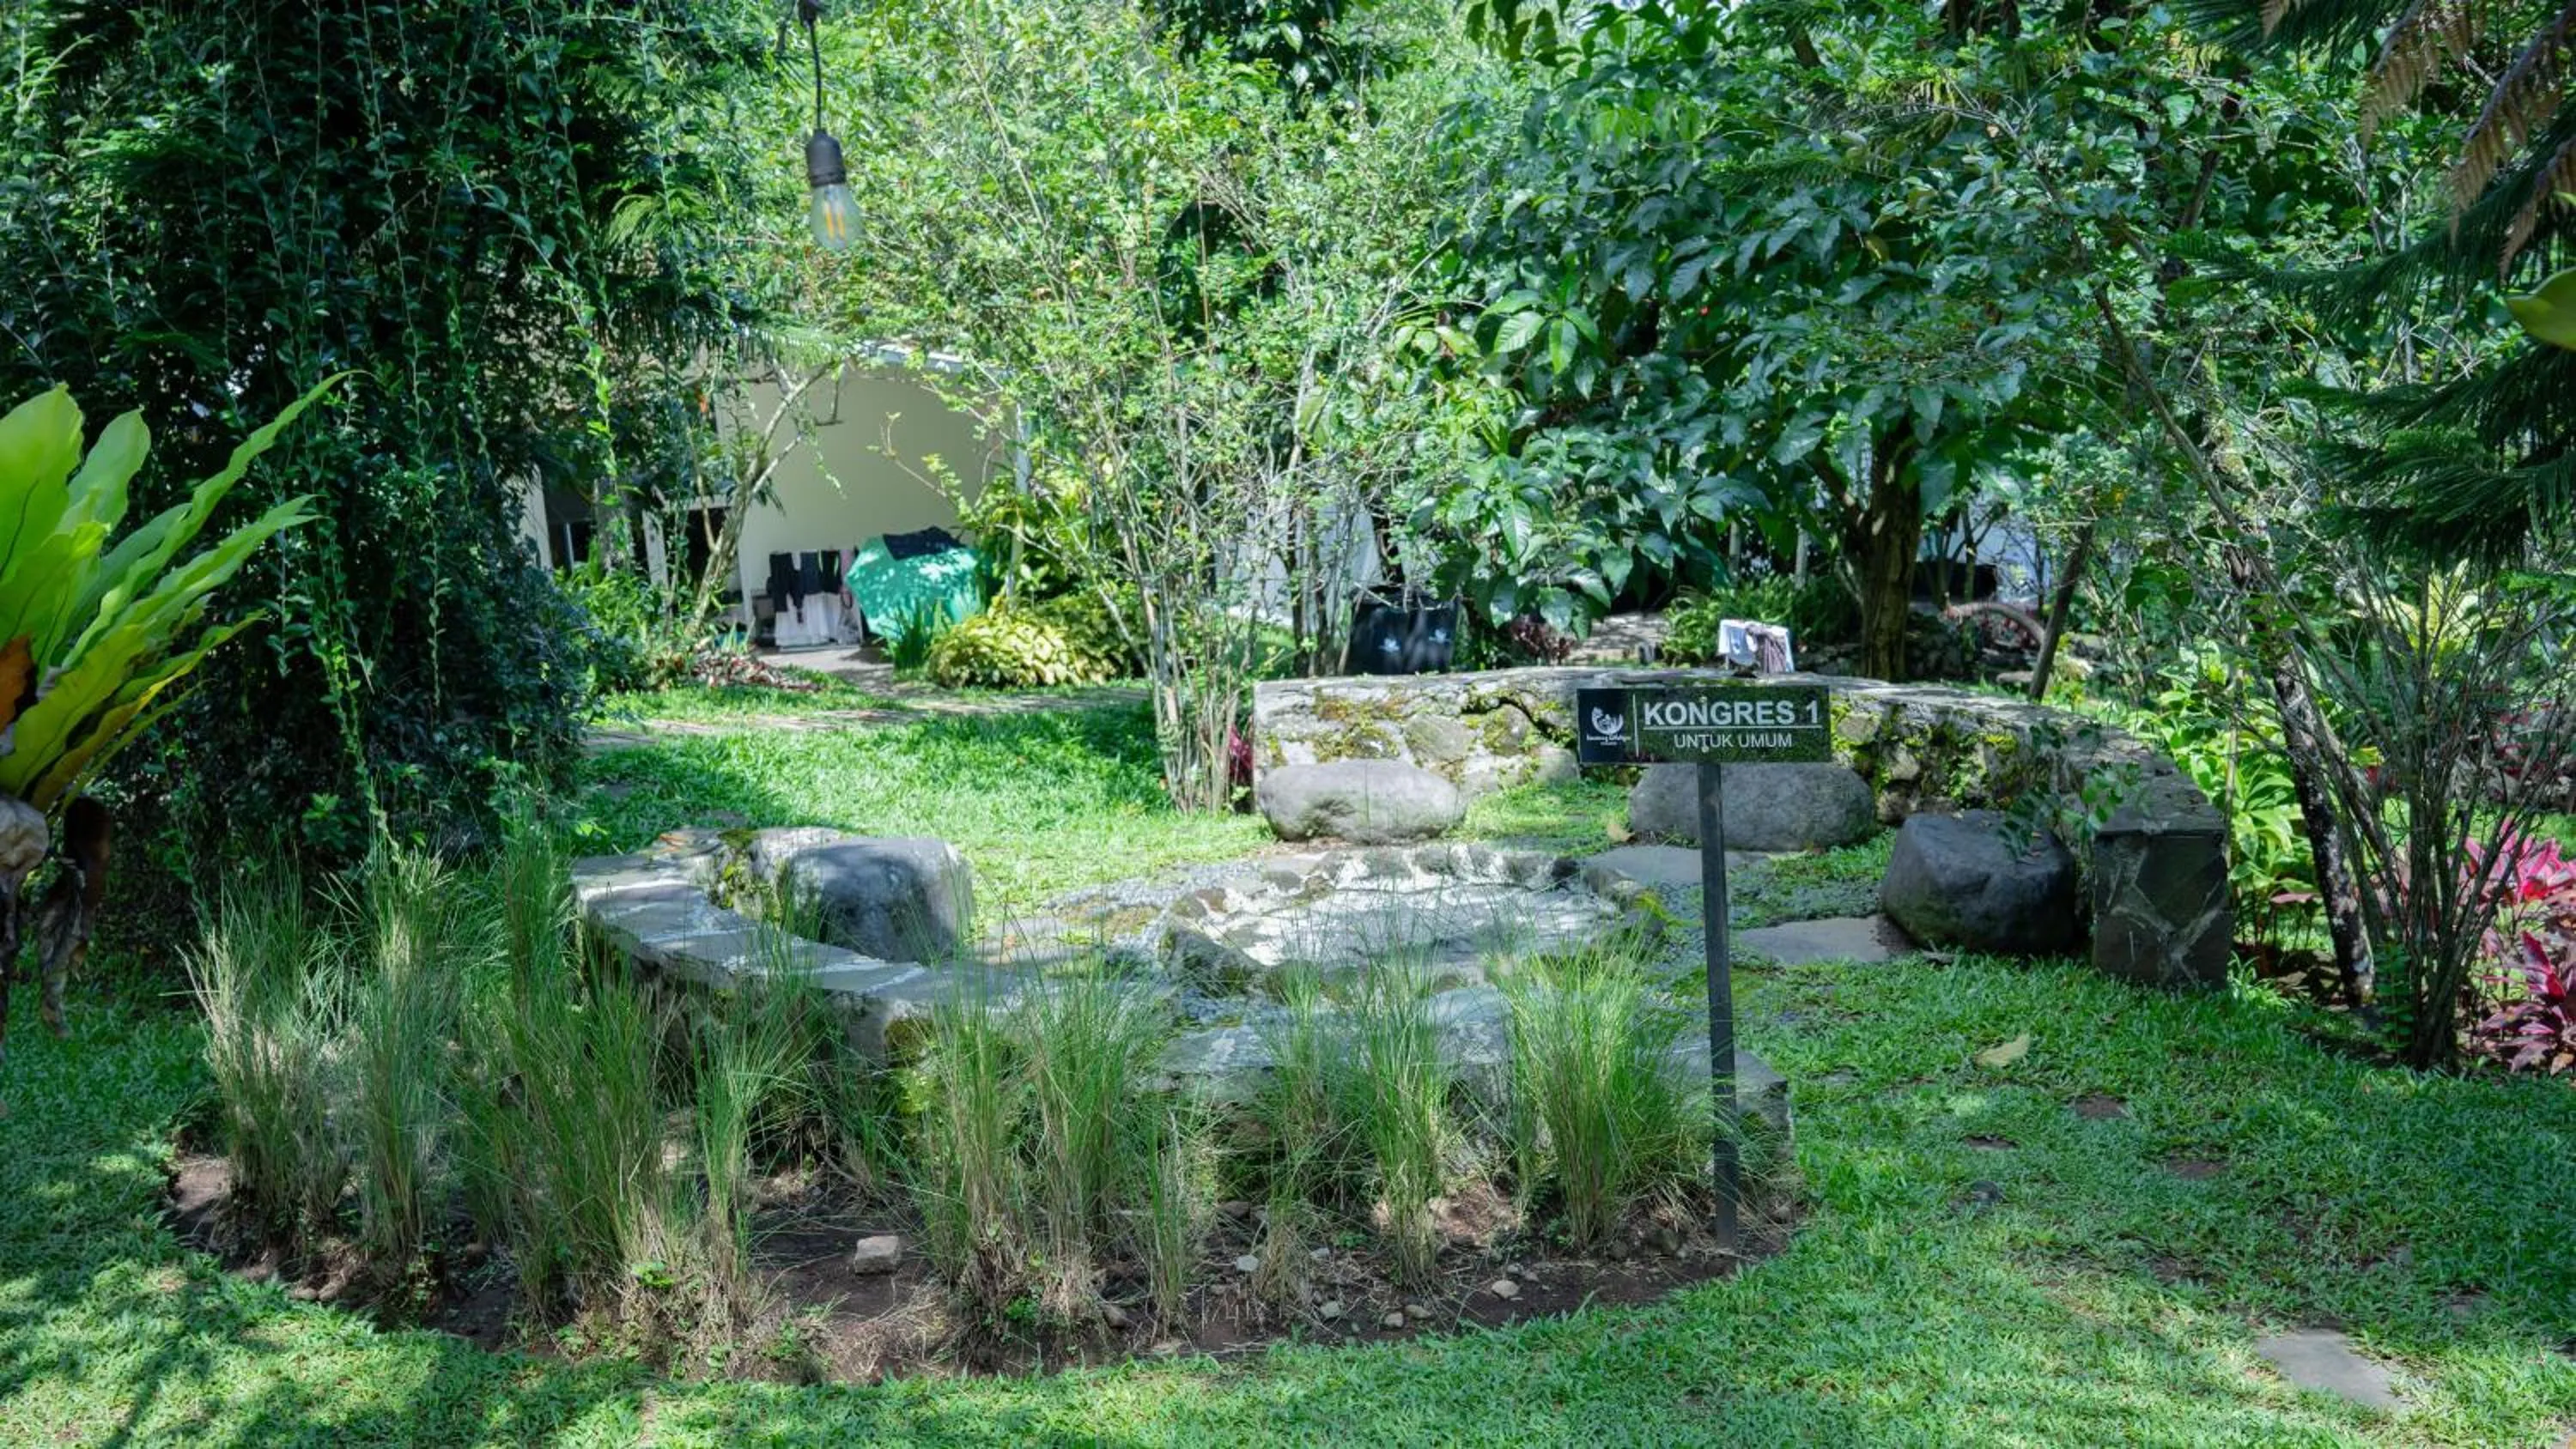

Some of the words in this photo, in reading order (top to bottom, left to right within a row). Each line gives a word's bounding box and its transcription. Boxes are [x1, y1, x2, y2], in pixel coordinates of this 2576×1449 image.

[1643, 700, 1795, 725] KONGRES
[1806, 701, 1819, 724] 1
[1674, 734, 1733, 748] UNTUK
[1740, 734, 1792, 748] UMUM
